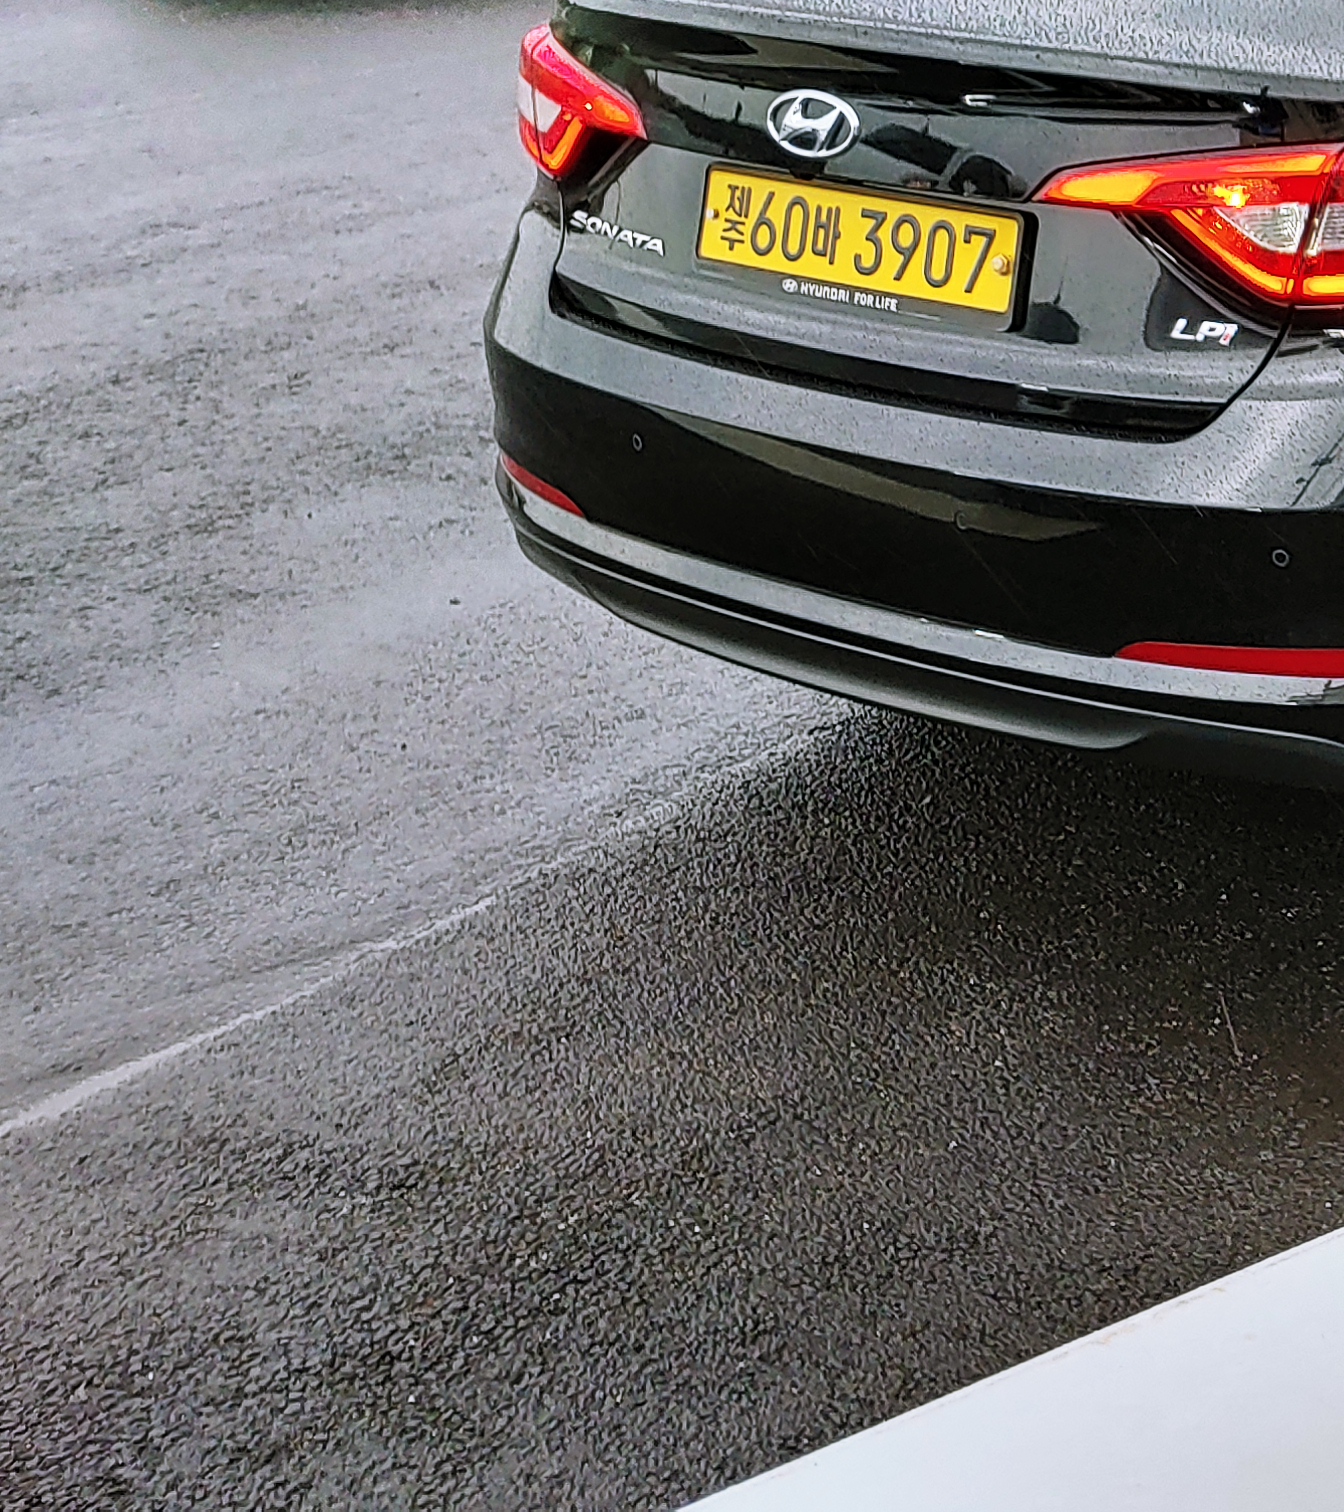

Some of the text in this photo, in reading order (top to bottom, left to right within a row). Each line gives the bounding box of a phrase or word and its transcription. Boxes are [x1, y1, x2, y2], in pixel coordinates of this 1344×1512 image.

[569, 209, 665, 257] SONATA
[854, 207, 996, 293] 3907
[800, 281, 850, 304] HYUNDAI
